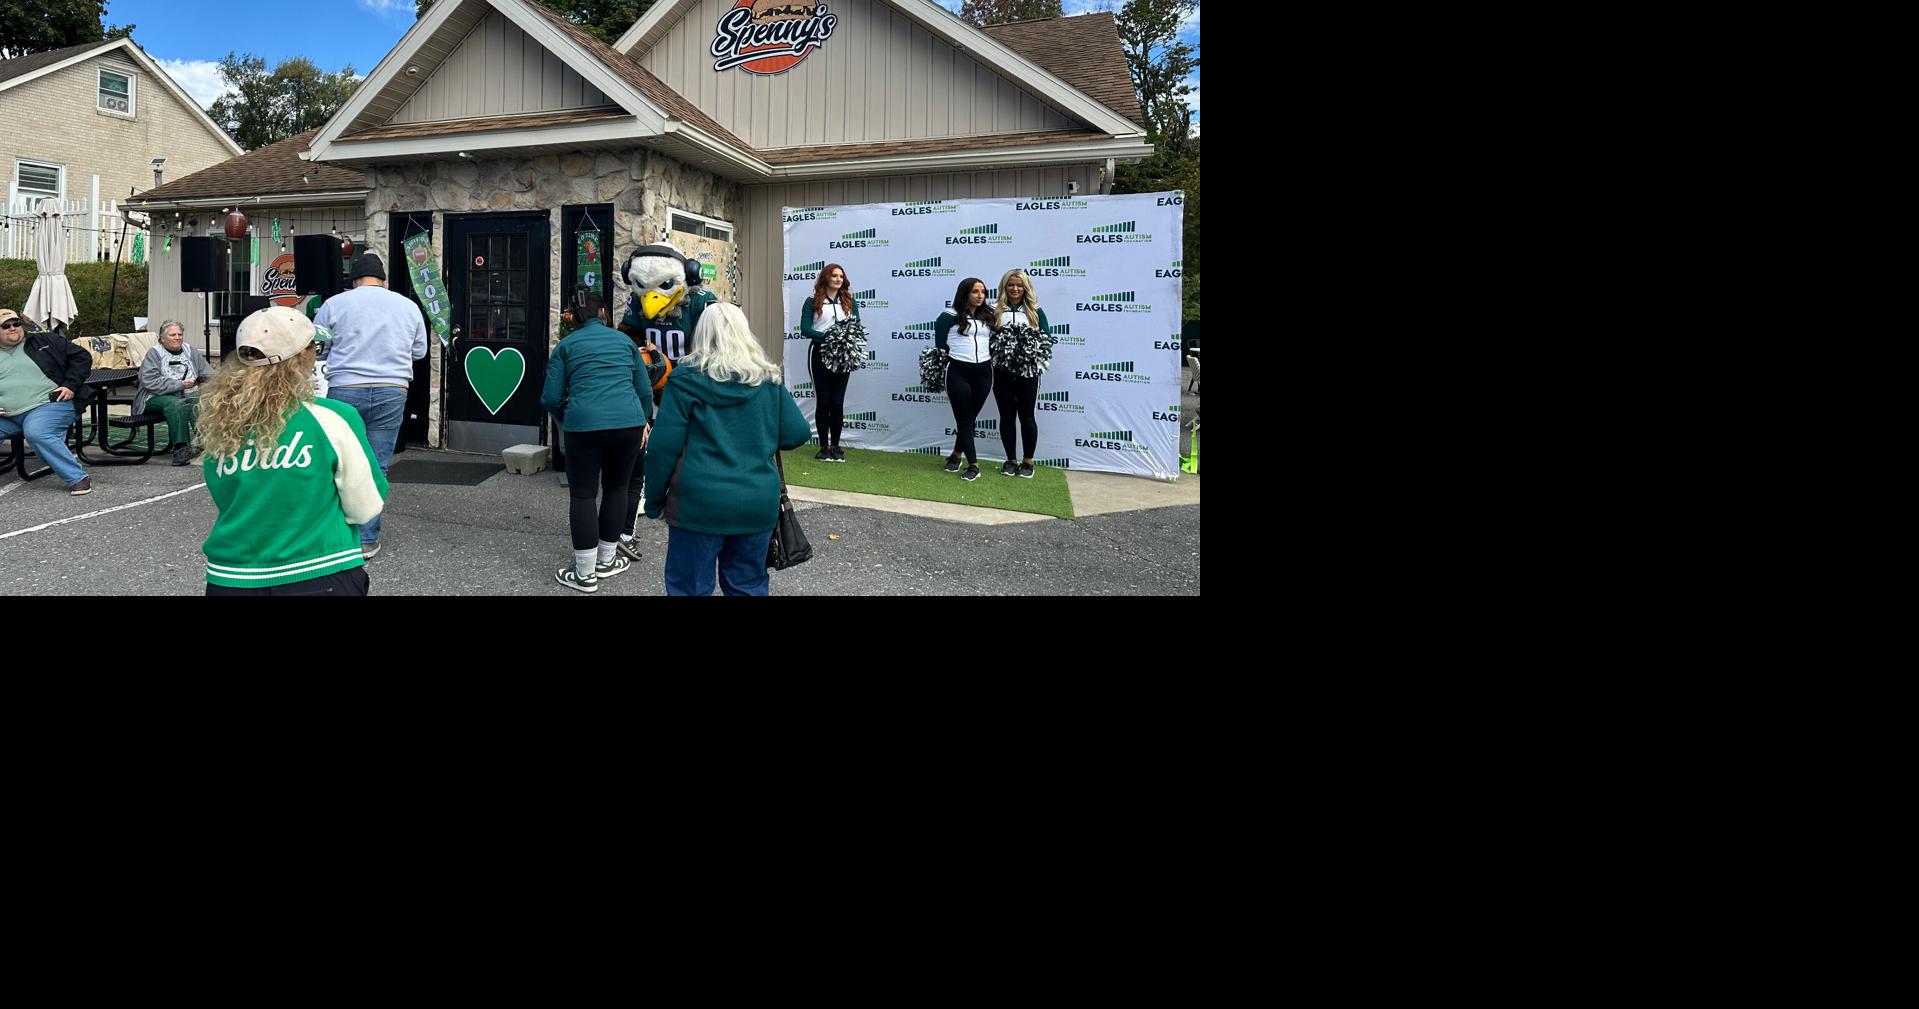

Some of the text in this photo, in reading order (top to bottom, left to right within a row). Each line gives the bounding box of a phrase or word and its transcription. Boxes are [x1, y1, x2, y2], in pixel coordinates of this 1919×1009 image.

[710, 4, 838, 71] Spenny's
[1156, 196, 1183, 206] EAG
[1016, 201, 1060, 211] EAGLES
[891, 206, 932, 216] EAGLES
[783, 213, 816, 222] EAGLES
[945, 236, 987, 245] EAGLES
[1076, 234, 1123, 243] EAGLES
[829, 240, 867, 249] EAGLES
[783, 272, 816, 280] EAGLES
[891, 269, 931, 277] EAGLES
[1024, 268, 1059, 277] AGLES
[1155, 269, 1183, 278] EAG
[261, 266, 297, 298] Spen
[1076, 303, 1123, 312] EAGLES
[891, 332, 931, 340] EAGLES
[646, 327, 685, 361] 00
[1075, 371, 1122, 382] EAGLES
[891, 393, 931, 403] EAGLES
[1037, 402, 1058, 411] LES
[1152, 411, 1179, 422] EAG
[842, 421, 867, 430] GLES
[1074, 439, 1121, 451] EAGLES
[215, 431, 313, 478] Birds
